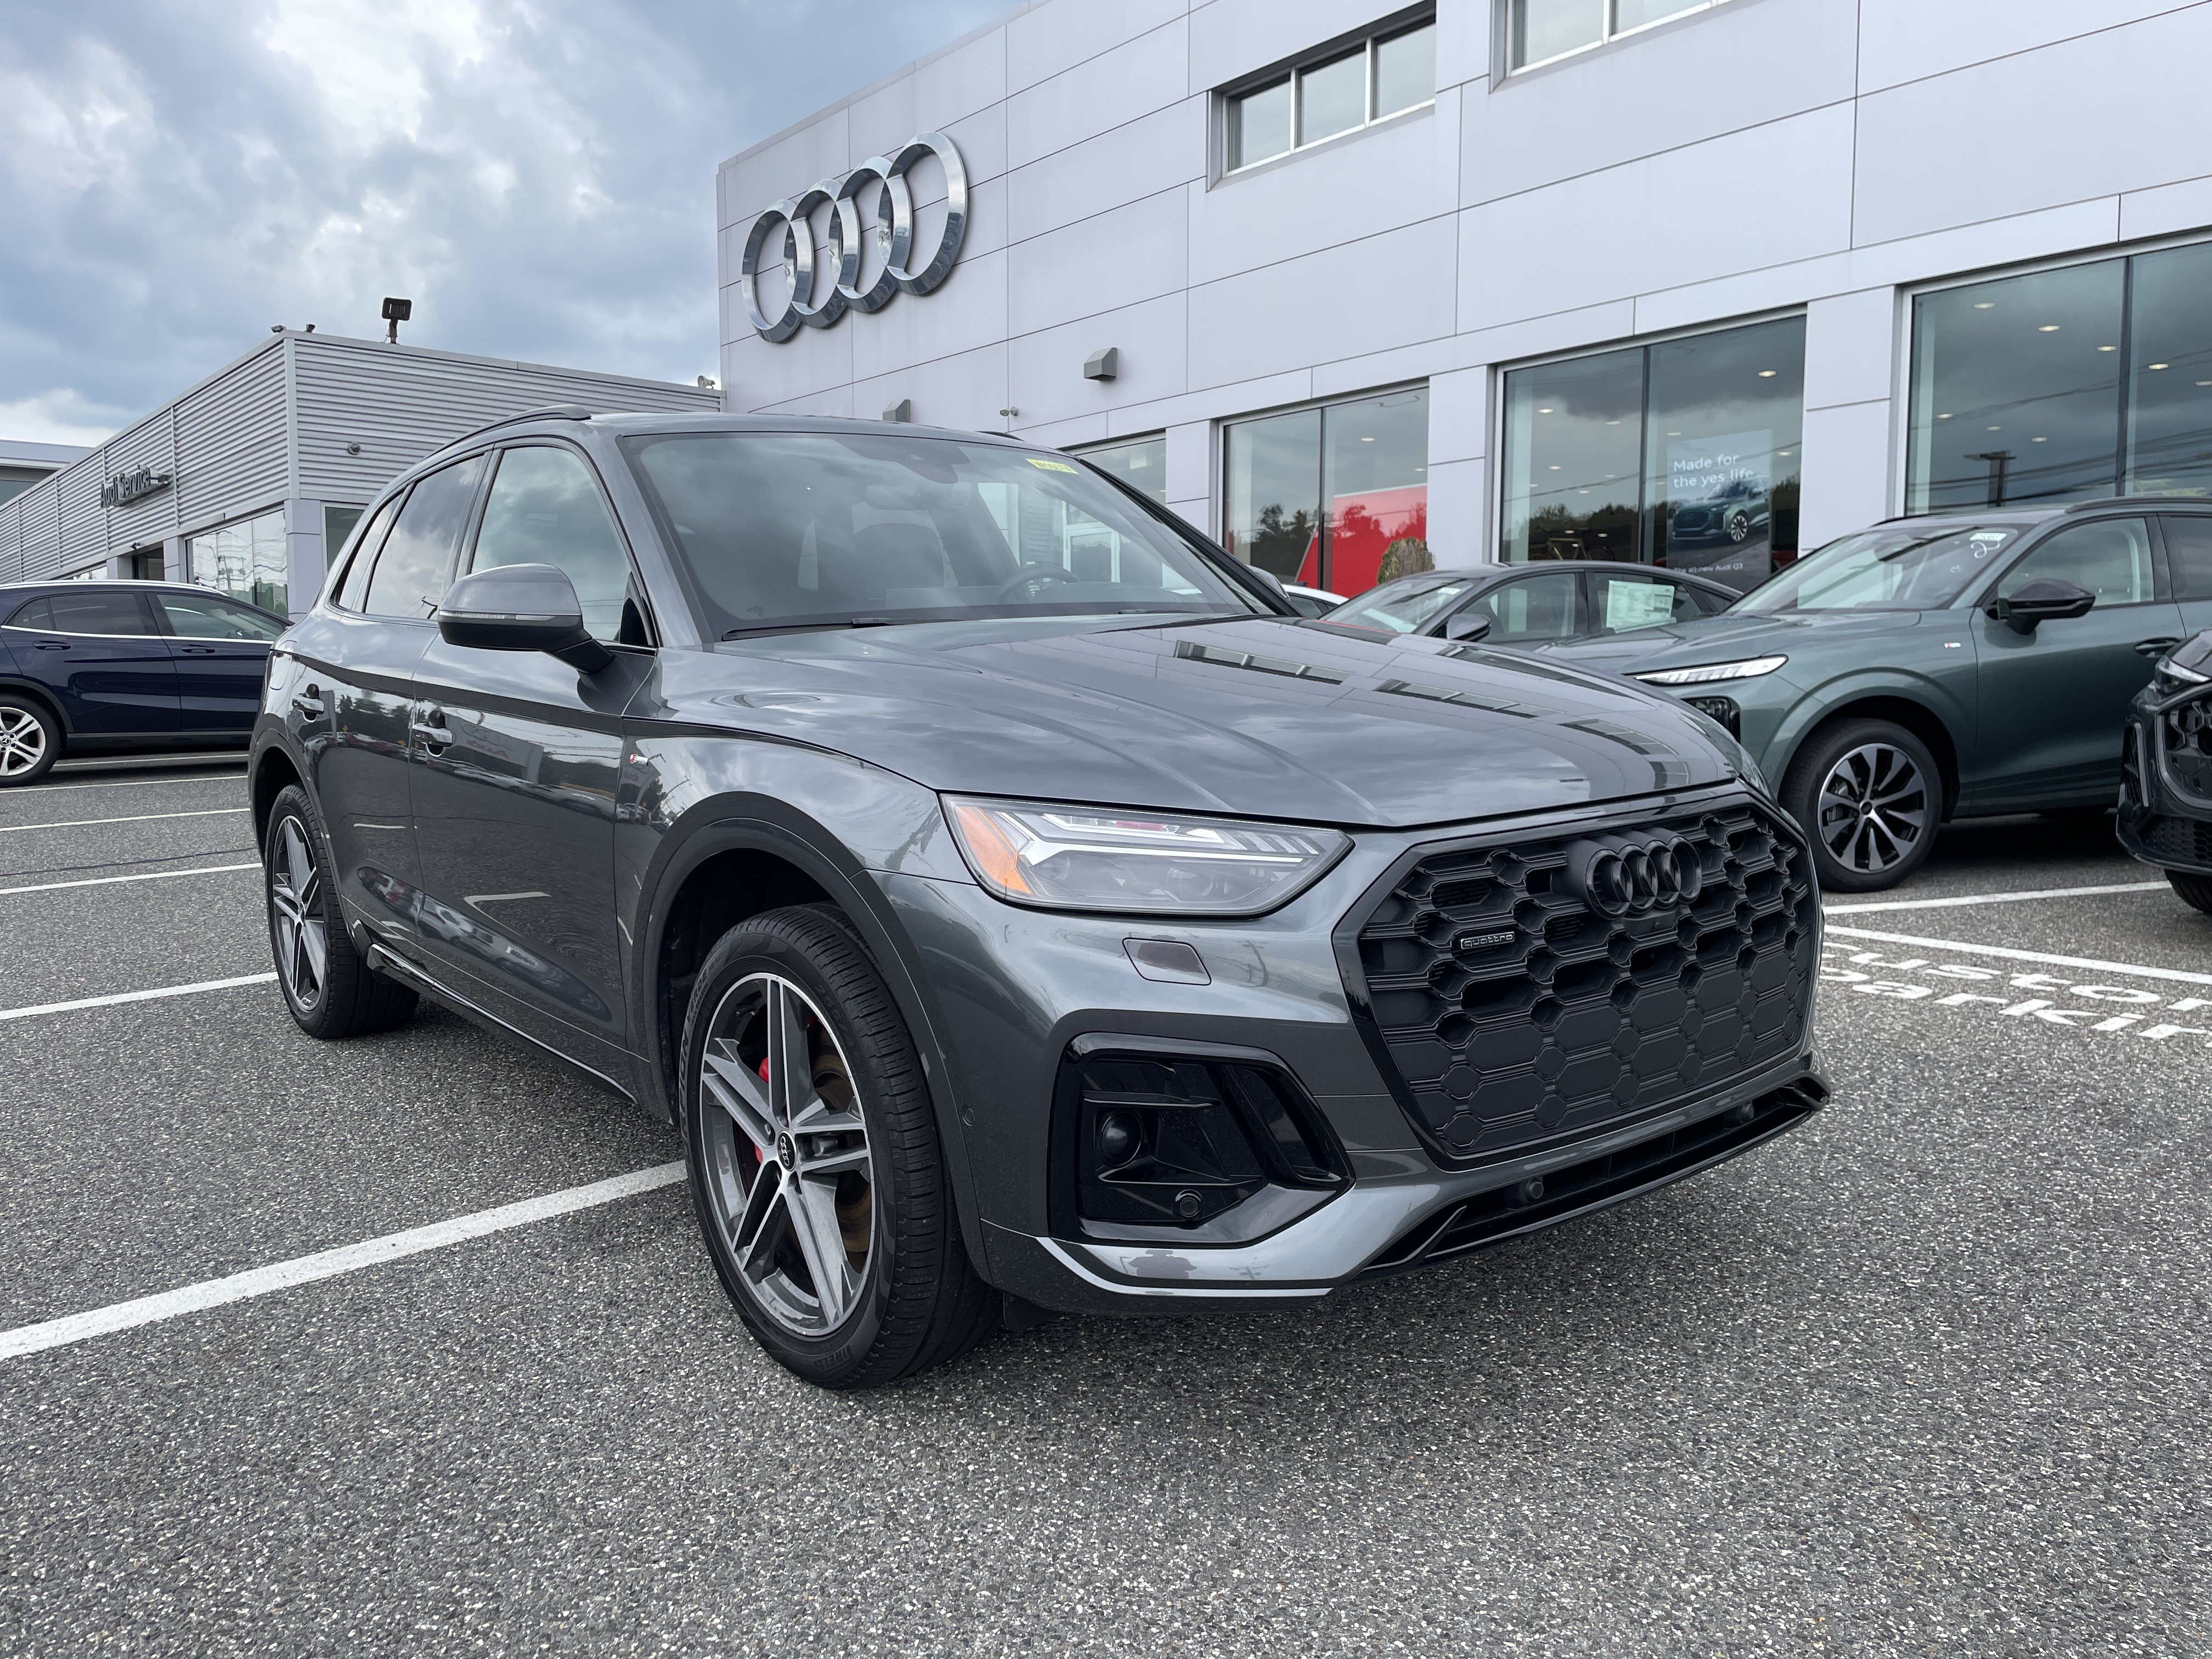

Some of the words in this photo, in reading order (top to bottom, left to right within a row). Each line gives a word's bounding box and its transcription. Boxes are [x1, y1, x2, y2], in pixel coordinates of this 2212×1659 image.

[1673, 456, 1712, 472] Made
[1717, 454, 1740, 466] for
[100, 476, 119, 508] Audi
[120, 464, 151, 498] Service
[1673, 476, 1697, 488] the
[1701, 472, 1725, 488] yes
[1730, 467, 1755, 481] life
[1688, 565, 1714, 573] all-new
[1715, 563, 1732, 572] Audi
[1733, 562, 1743, 571] Q3
[1464, 934, 1513, 947] quattro
